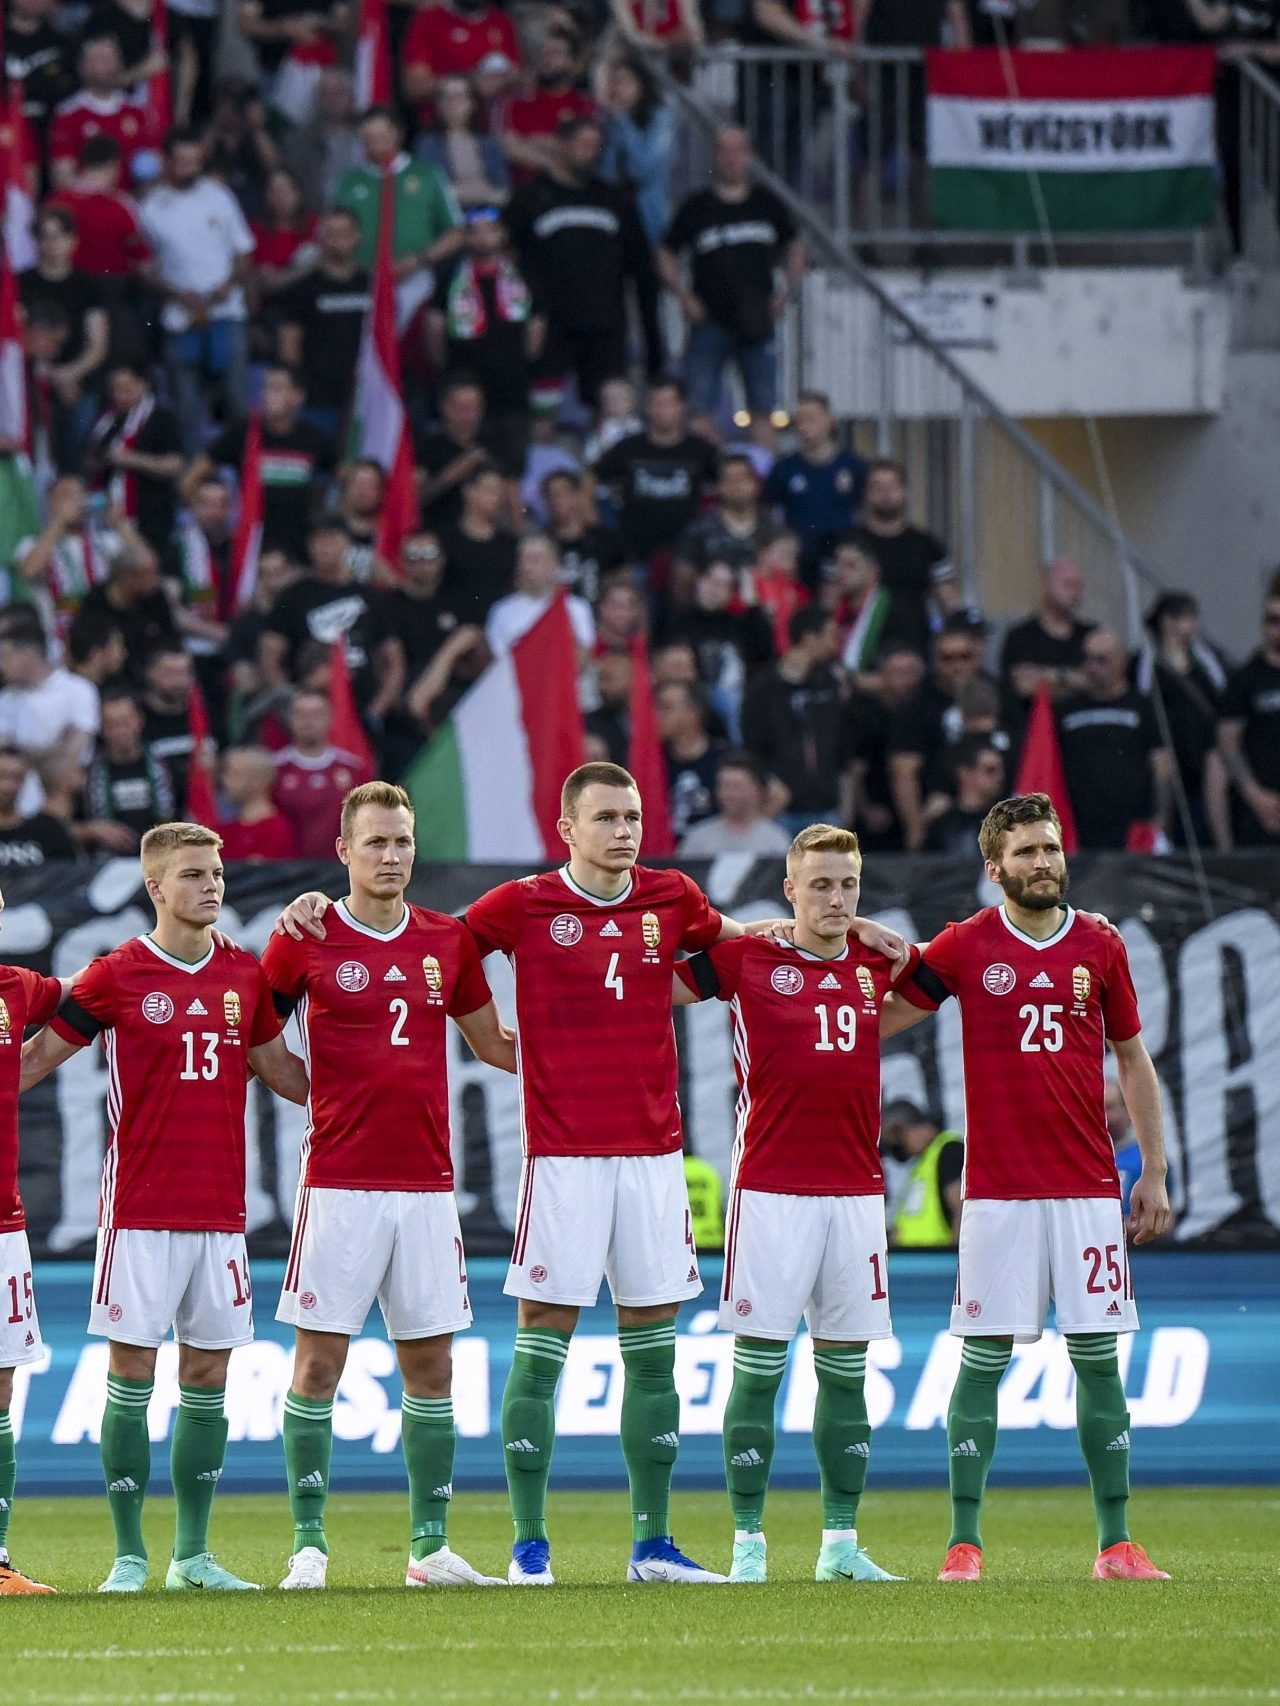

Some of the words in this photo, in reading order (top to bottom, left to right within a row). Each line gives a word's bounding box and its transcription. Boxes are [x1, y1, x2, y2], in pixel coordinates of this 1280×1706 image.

[605, 952, 624, 1000] 4
[389, 998, 410, 1045] 2
[814, 1004, 857, 1052] 19
[1019, 1003, 1064, 1052] 25
[180, 1031, 218, 1080] 13
[1083, 1244, 1122, 1294] 25
[8, 1271, 32, 1324] 15
[506, 1444, 539, 1453] adidas
[731, 1457, 764, 1467] adidas
[109, 1484, 139, 1492] adidas
